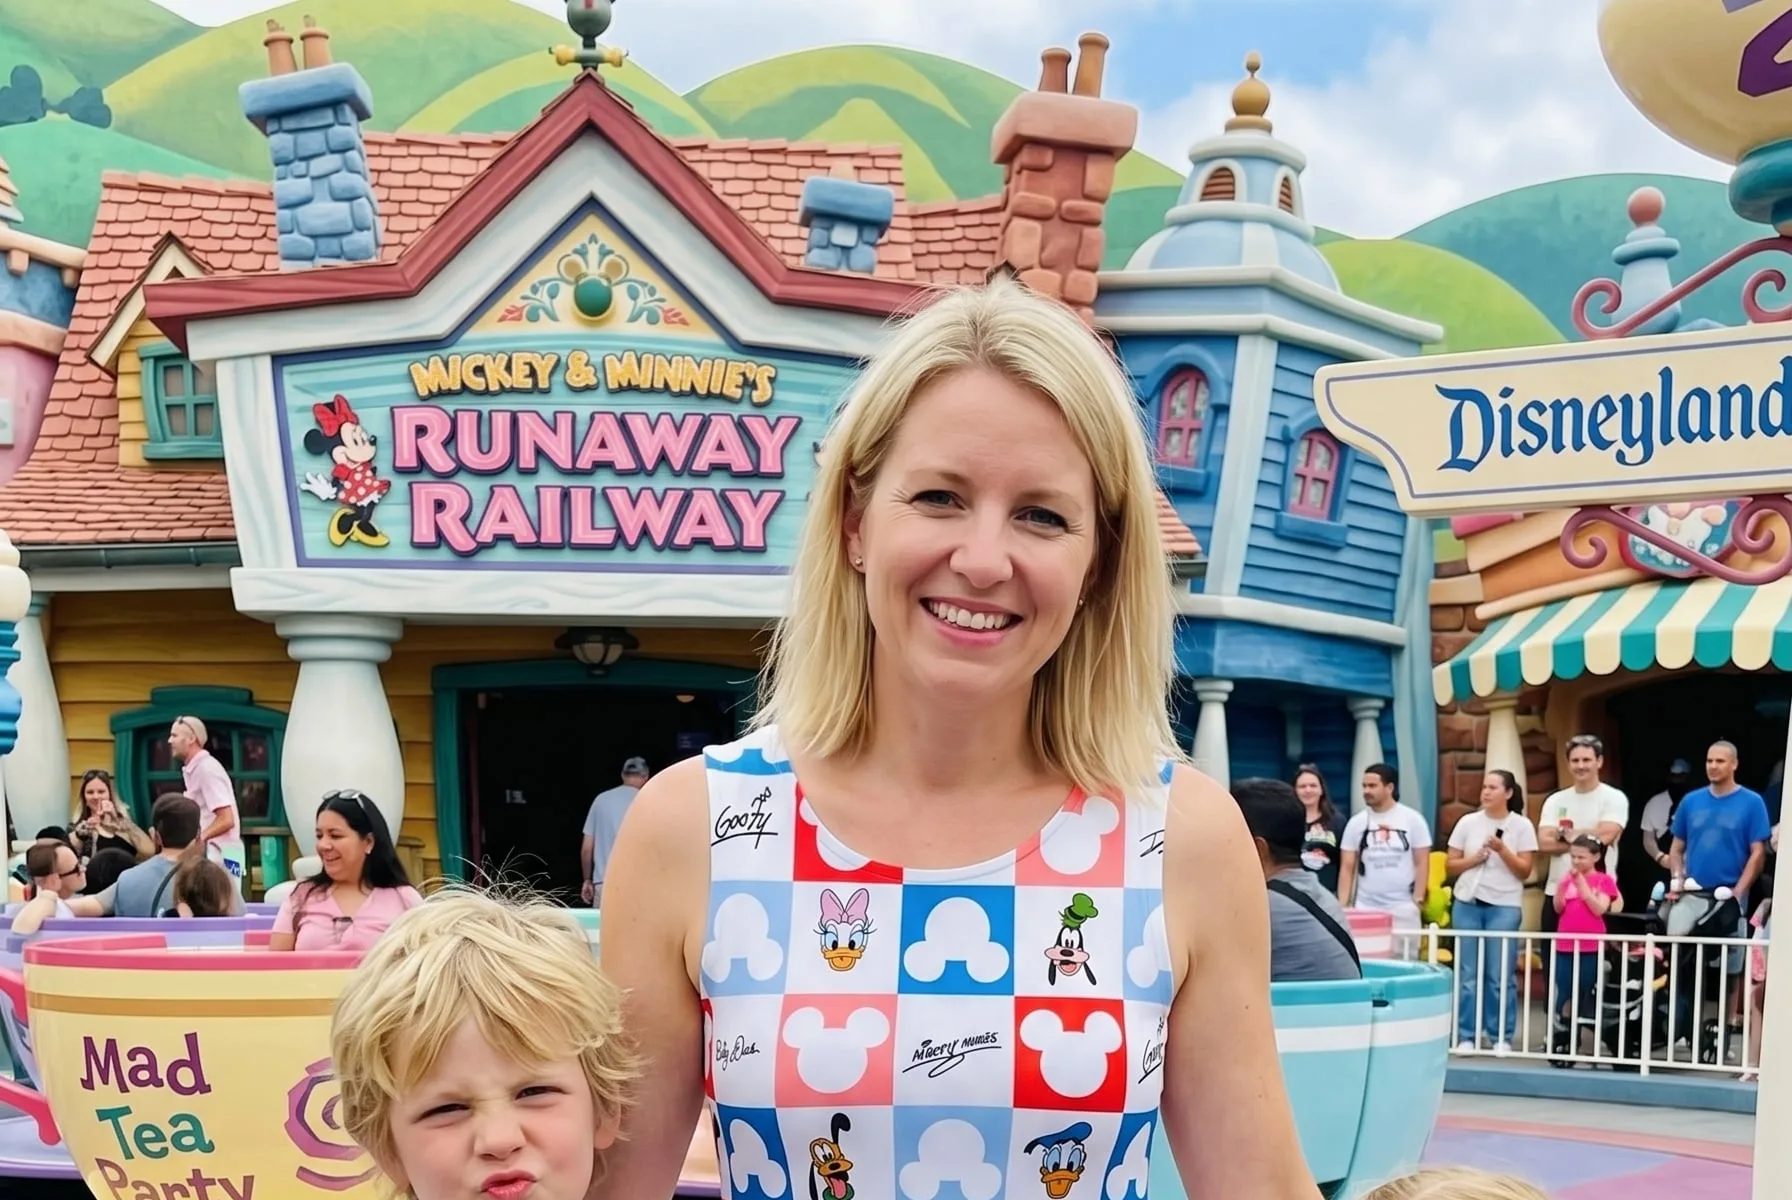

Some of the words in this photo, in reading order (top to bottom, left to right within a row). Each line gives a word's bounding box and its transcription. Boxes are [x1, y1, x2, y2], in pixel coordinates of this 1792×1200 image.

[409, 351, 559, 398] MICKEY
[565, 350, 598, 390] &
[605, 351, 776, 404] MINNIE'S
[392, 405, 801, 477] RUNAWAY
[1435, 355, 1792, 472] Disneyland
[408, 481, 784, 555] RAILWAY
[80, 1032, 211, 1096] Mad
[96, 1105, 215, 1161] Tea
